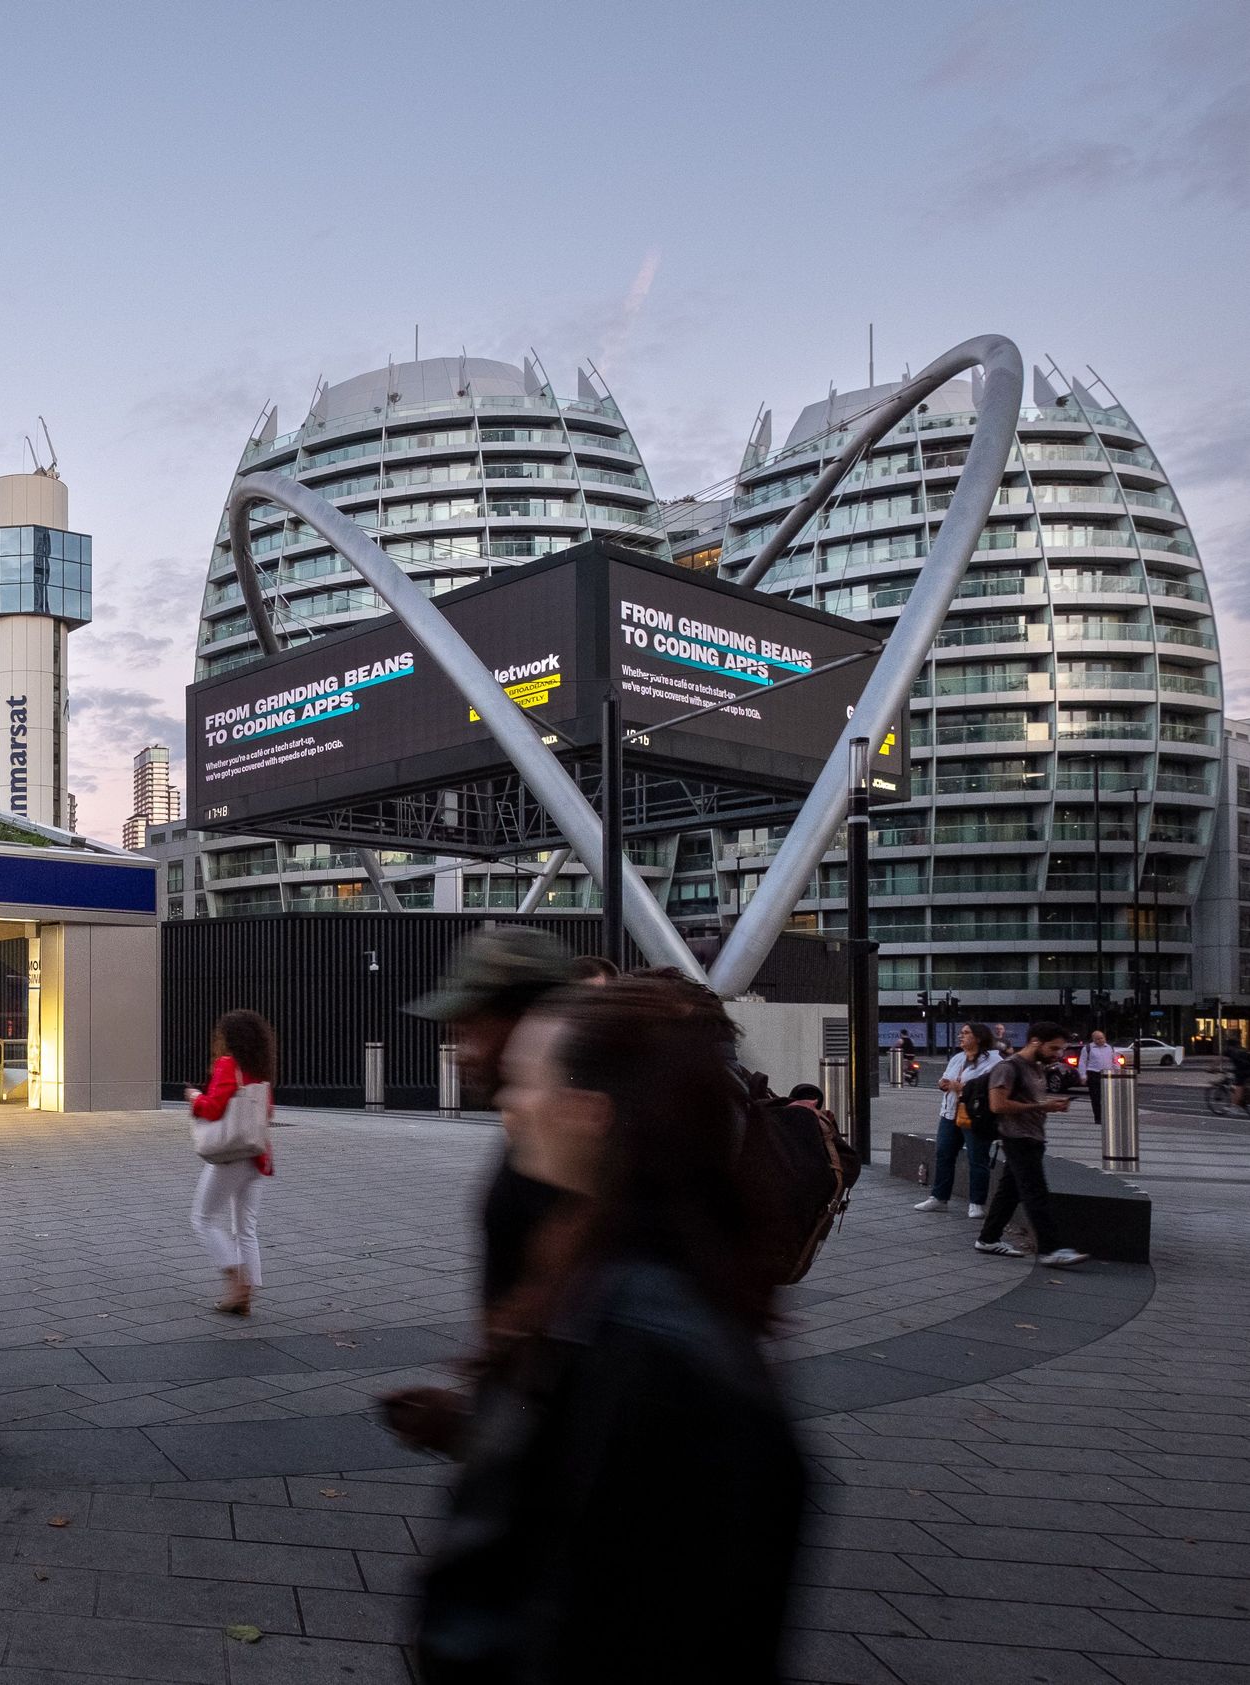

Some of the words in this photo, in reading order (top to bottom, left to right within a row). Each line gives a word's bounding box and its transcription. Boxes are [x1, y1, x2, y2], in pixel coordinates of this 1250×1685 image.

[621, 600, 673, 632] FROM
[678, 617, 756, 653] GRINDING
[761, 640, 812, 669] BEANS
[621, 624, 648, 648] TO
[654, 633, 719, 666] CODING
[205, 704, 250, 730] FROM
[255, 676, 338, 714] GRINDING
[344, 652, 414, 687] BEANS
[622, 664, 649, 680] Whether
[674, 678, 687, 689] café
[688, 683, 695, 691] or
[699, 683, 712, 695] tech
[622, 681, 640, 691] we've
[641, 685, 652, 695] got
[652, 689, 664, 699] you
[664, 690, 689, 704] covered
[690, 695, 703, 707] with
[739, 706, 745, 715] to
[205, 729, 227, 747] TO
[232, 708, 295, 739] CODING
[205, 773, 221, 782] we've
[221, 770, 230, 779] got
[230, 767, 241, 778] you
[241, 759, 265, 772] covered
[265, 756, 278, 766] with
[278, 750, 300, 764] speeds
[300, 747, 308, 757] of
[308, 747, 316, 757] up
[317, 745, 324, 753] to
[206, 760, 229, 771] Whether
[229, 756, 246, 767] you're
[250, 749, 263, 759] café
[275, 742, 288, 752] tech
